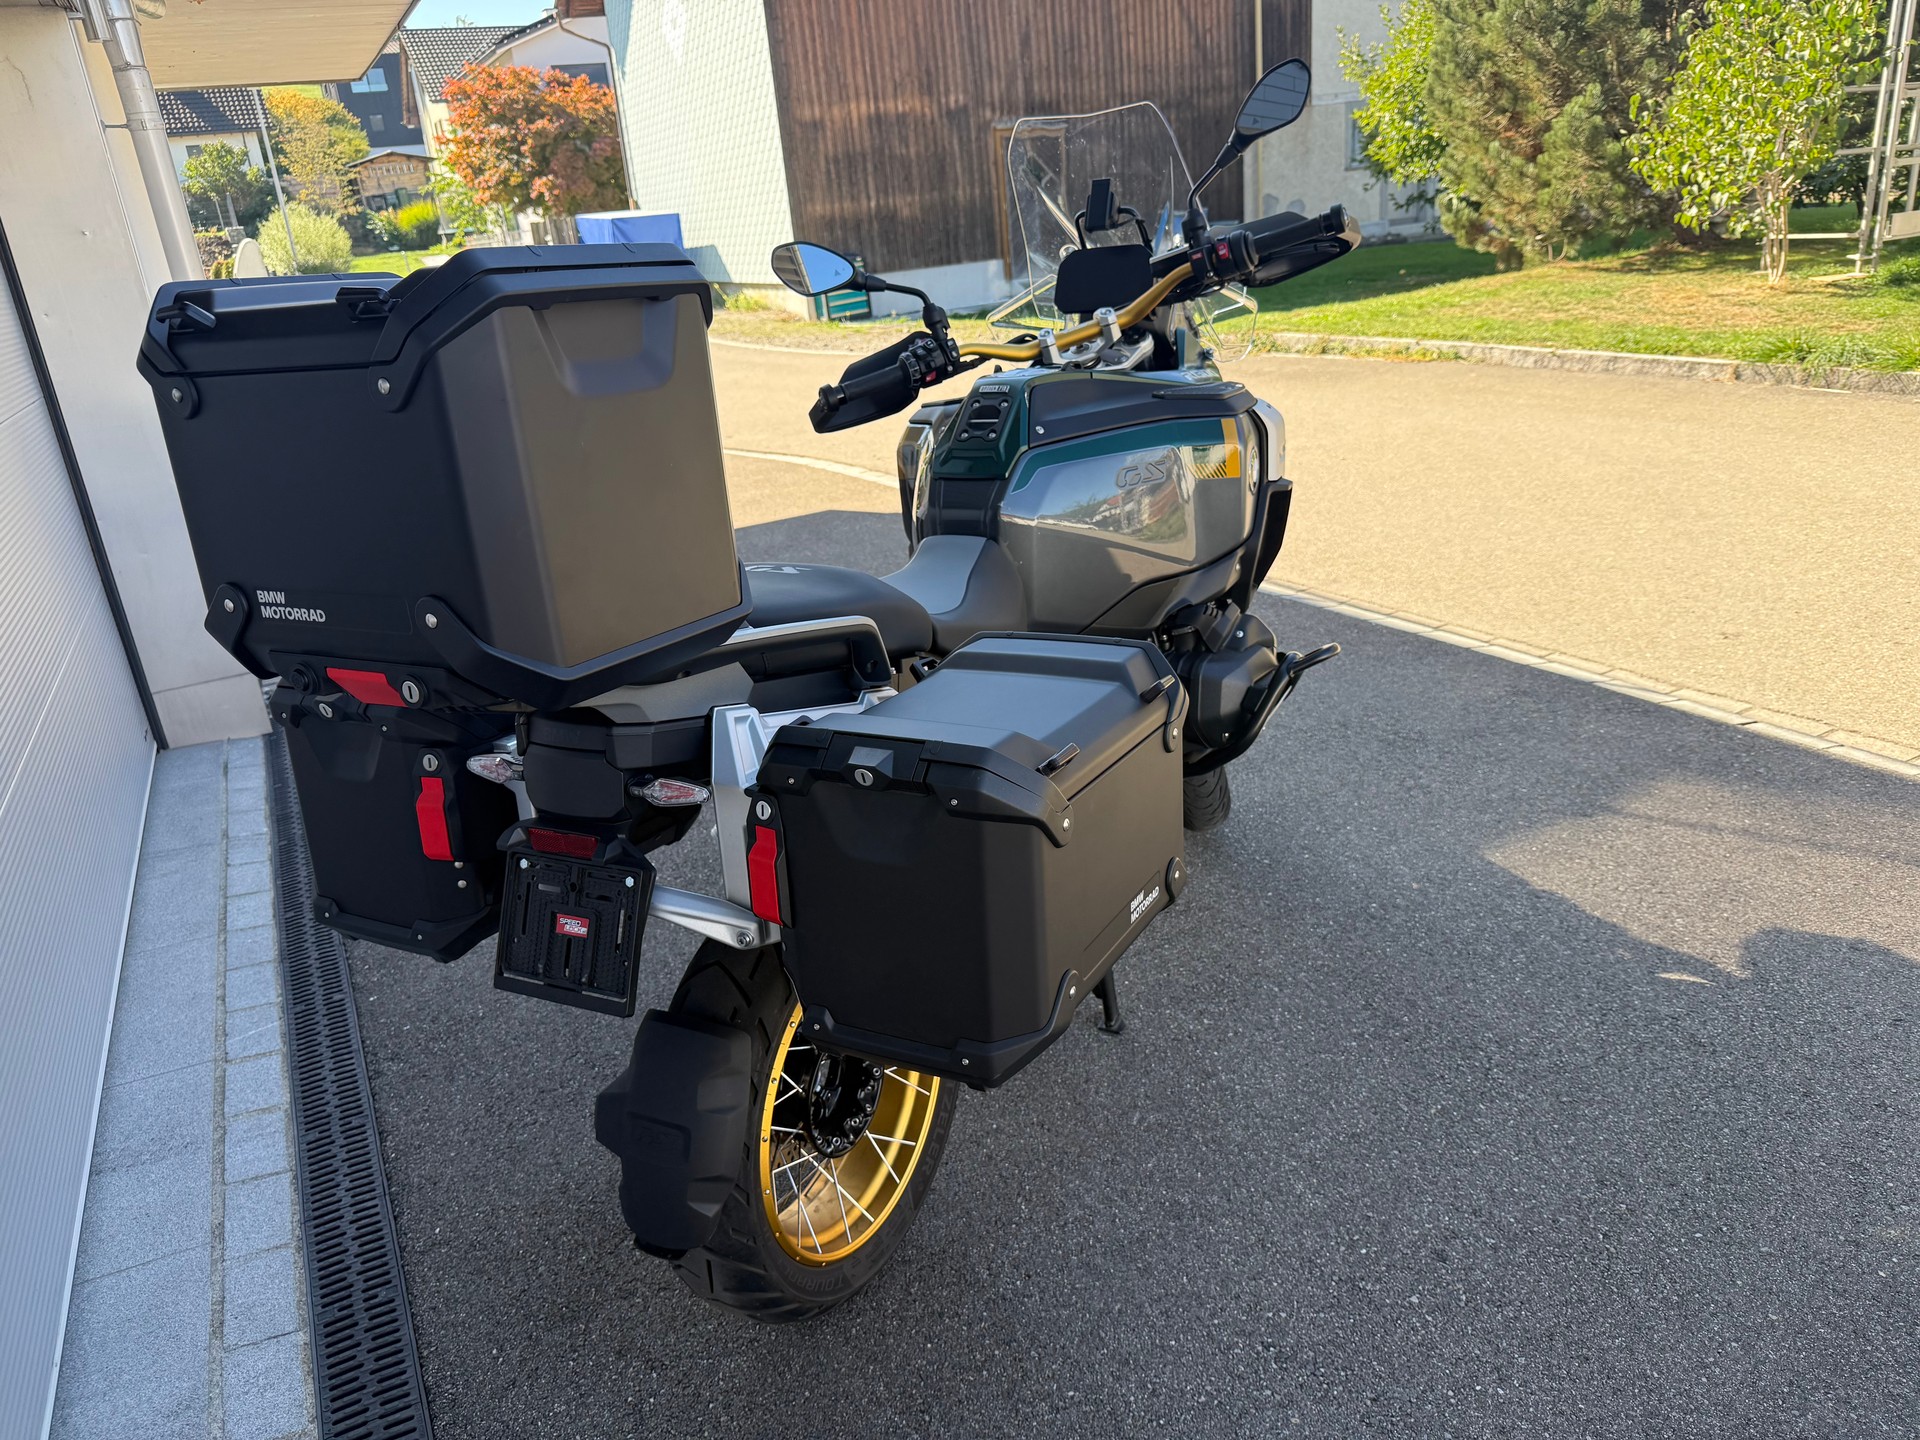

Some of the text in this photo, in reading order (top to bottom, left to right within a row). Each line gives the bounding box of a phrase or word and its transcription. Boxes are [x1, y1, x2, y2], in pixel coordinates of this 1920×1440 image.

[1116, 460, 1166, 488] GS
[256, 590, 286, 604] BMW
[260, 605, 326, 623] MOTORRAD
[1130, 889, 1145, 912] BMW
[1130, 885, 1160, 924] MOTORRAD
[559, 917, 582, 927] SPEED
[922, 1080, 955, 1176] TZELER
